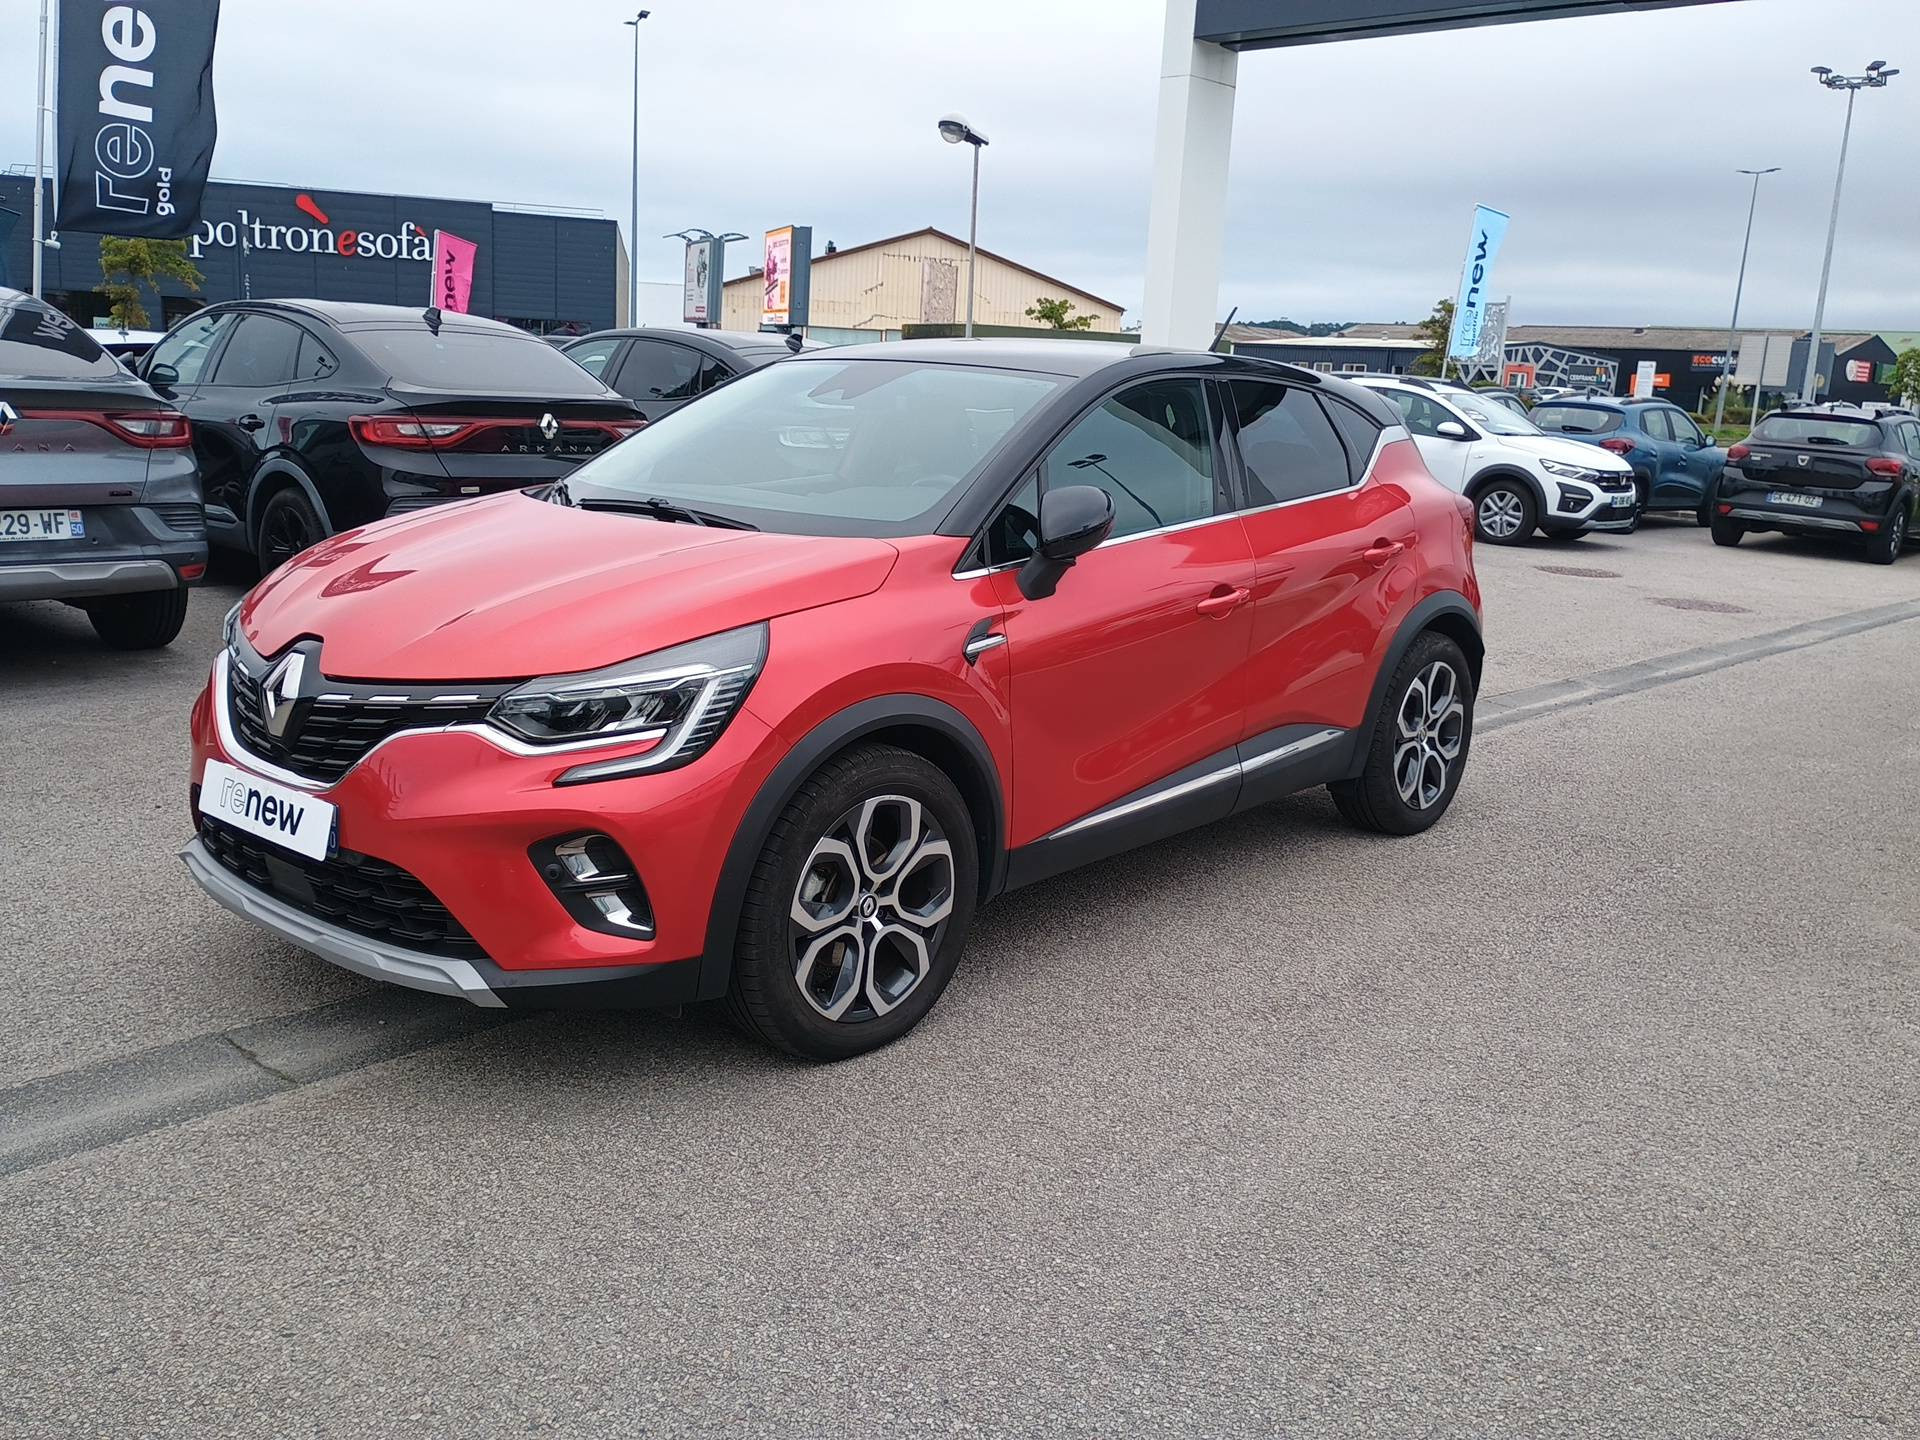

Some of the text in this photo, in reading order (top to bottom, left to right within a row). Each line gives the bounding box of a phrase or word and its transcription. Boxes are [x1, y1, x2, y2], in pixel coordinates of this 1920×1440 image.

[94, 0, 157, 214] rene
[155, 166, 176, 216] gold
[1459, 229, 1489, 347] renew
[501, 444, 593, 453] ARKANA
[0, 512, 65, 537] 29-WF
[71, 523, 83, 534] 50
[220, 777, 305, 836] renew
